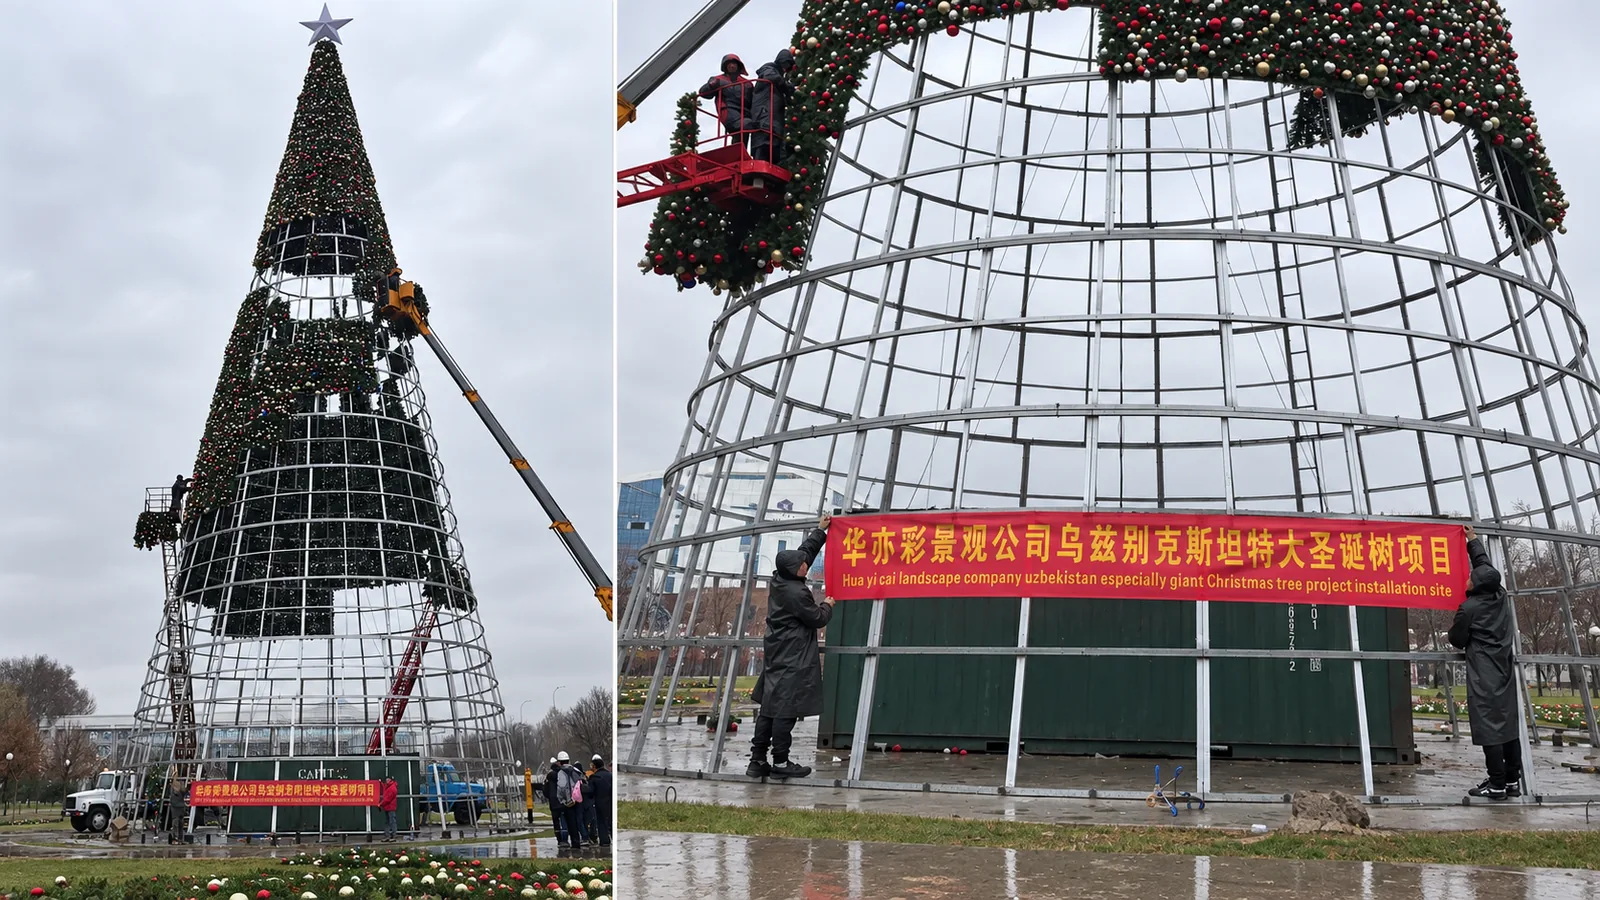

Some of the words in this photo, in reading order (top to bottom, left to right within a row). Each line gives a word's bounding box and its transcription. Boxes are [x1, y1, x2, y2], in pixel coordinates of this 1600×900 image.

[842, 522, 1452, 575] 华亦彩景观公司乌兹别克斯坦特大圣诞树项目
[843, 573, 864, 587] Hua
[867, 573, 877, 589] yi
[879, 572, 896, 586] cai
[899, 571, 961, 587] landscape
[963, 572, 1021, 587] company
[1025, 569, 1097, 585] uzbekistan
[1100, 571, 1167, 589] especially
[1169, 573, 1204, 591] giant
[1207, 572, 1274, 590] Christmas
[1276, 577, 1303, 591] tree
[1306, 578, 1352, 596] project
[1355, 579, 1427, 596] installation
[1429, 583, 1452, 598] site
